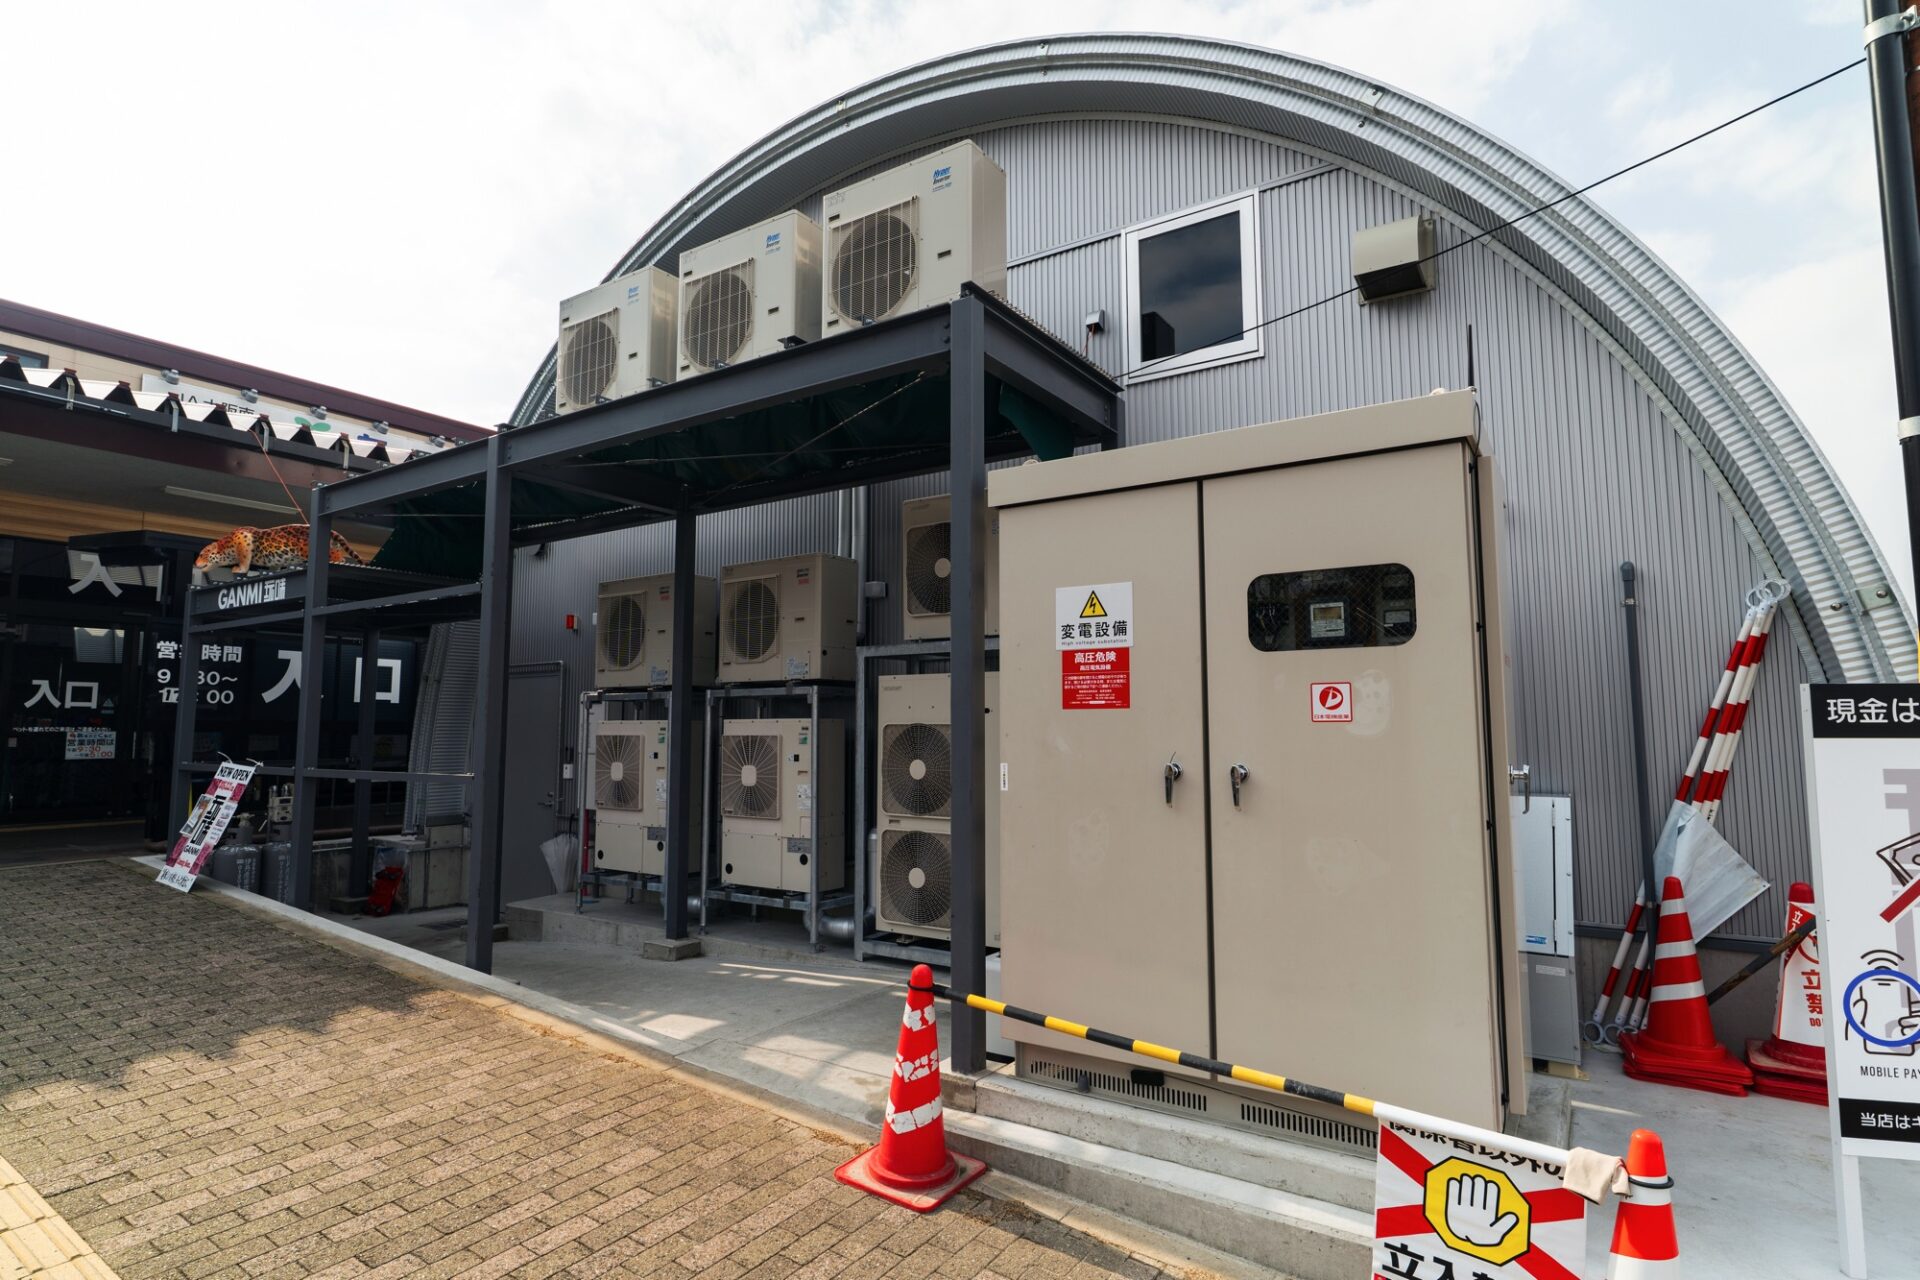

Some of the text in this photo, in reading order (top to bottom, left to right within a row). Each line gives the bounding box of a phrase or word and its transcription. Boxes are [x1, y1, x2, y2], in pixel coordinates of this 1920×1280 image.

[218, 581, 262, 610] GANMI
[1061, 620, 1127, 640] 変電設備
[156, 640, 242, 664] 営時間
[1074, 651, 1117, 664] 高圧危険
[24, 679, 99, 709] 入口
[1826, 697, 1920, 723] 現金は
[217, 766, 252, 781] NEW OPEN
[1860, 1065, 1900, 1079] MOBILE
[1382, 1242, 1495, 1280] 立入
